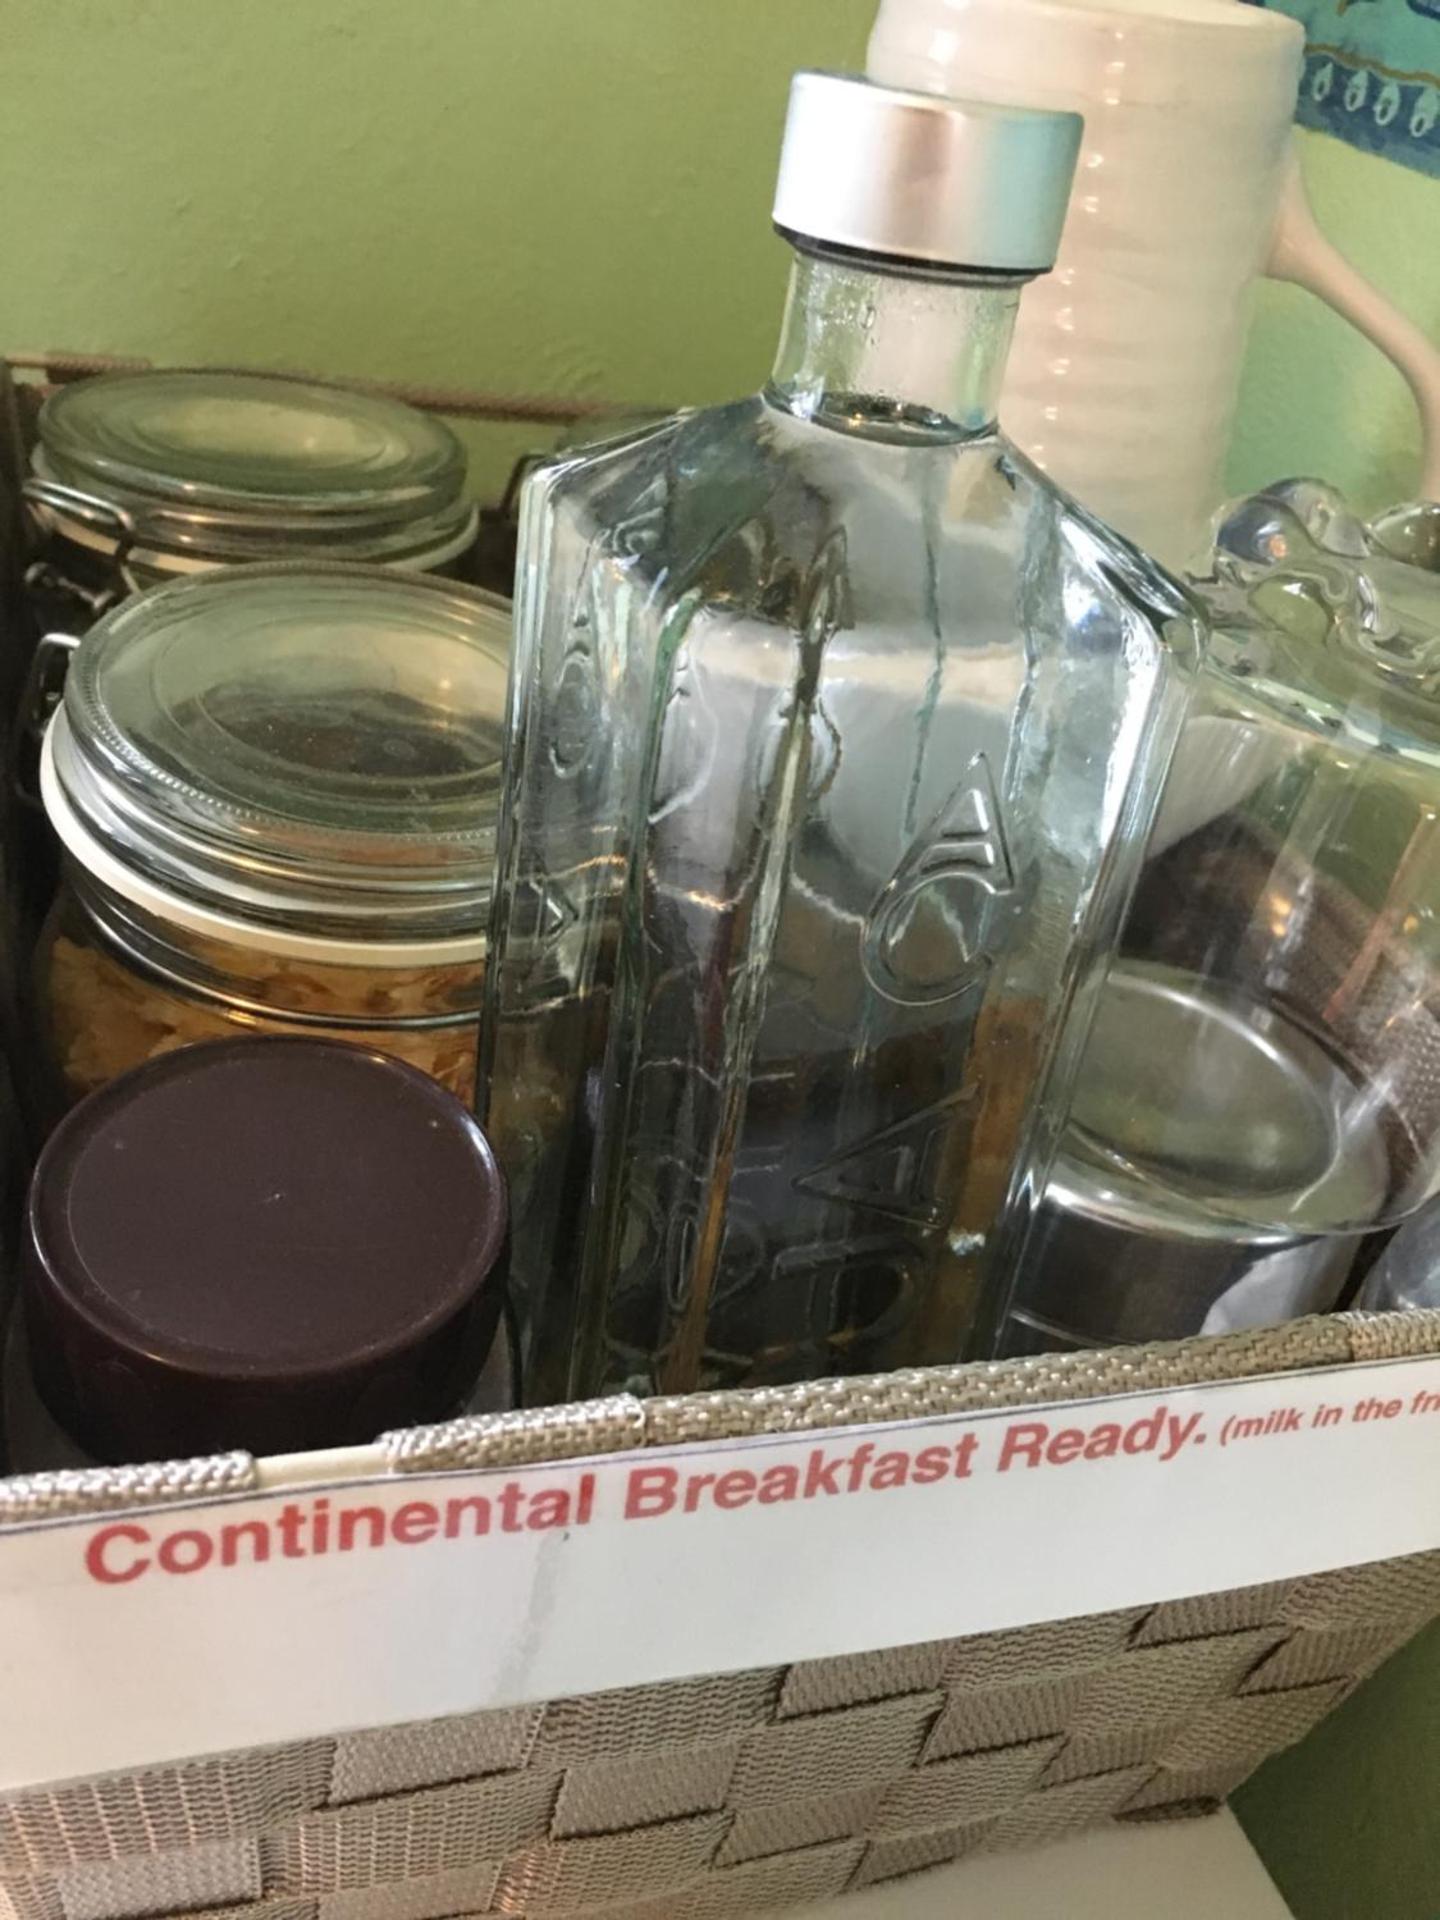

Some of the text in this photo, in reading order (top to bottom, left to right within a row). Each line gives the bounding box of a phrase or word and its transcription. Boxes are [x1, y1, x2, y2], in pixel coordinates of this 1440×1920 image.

[83, 1472, 597, 1585] Continental
[624, 1431, 980, 1520] Breakfast
[996, 1405, 1207, 1473] Ready.
[1219, 1408, 1304, 1446] (milk
[1311, 1403, 1345, 1429] in
[1352, 1397, 1404, 1423] the
